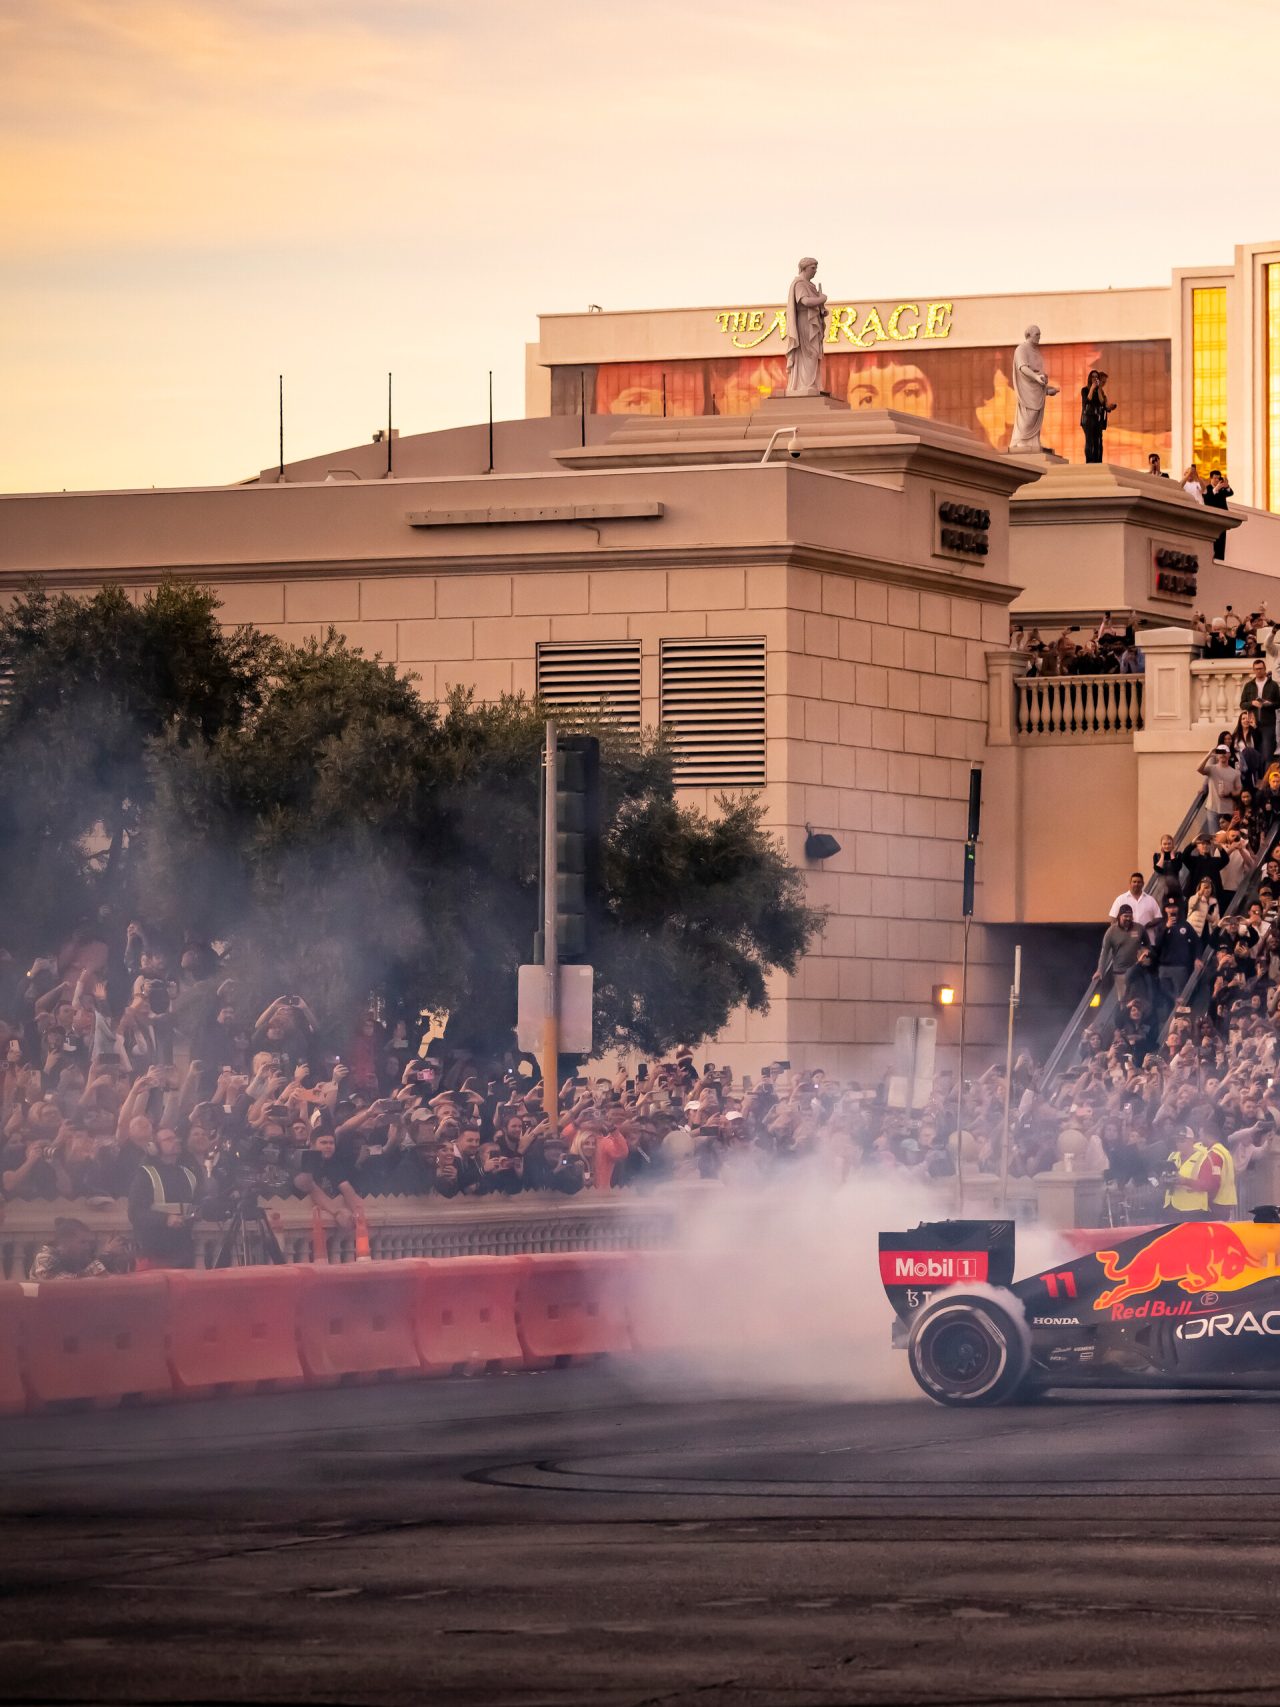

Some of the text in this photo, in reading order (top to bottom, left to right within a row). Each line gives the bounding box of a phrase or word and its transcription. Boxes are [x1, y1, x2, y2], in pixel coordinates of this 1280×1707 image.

[716, 303, 953, 349] THE MRAGE
[895, 1258, 953, 1277] Mobil
[1039, 1271, 1078, 1297] 11
[1111, 1301, 1191, 1320] Red Bull
[1033, 1317, 1079, 1325] HONDA
